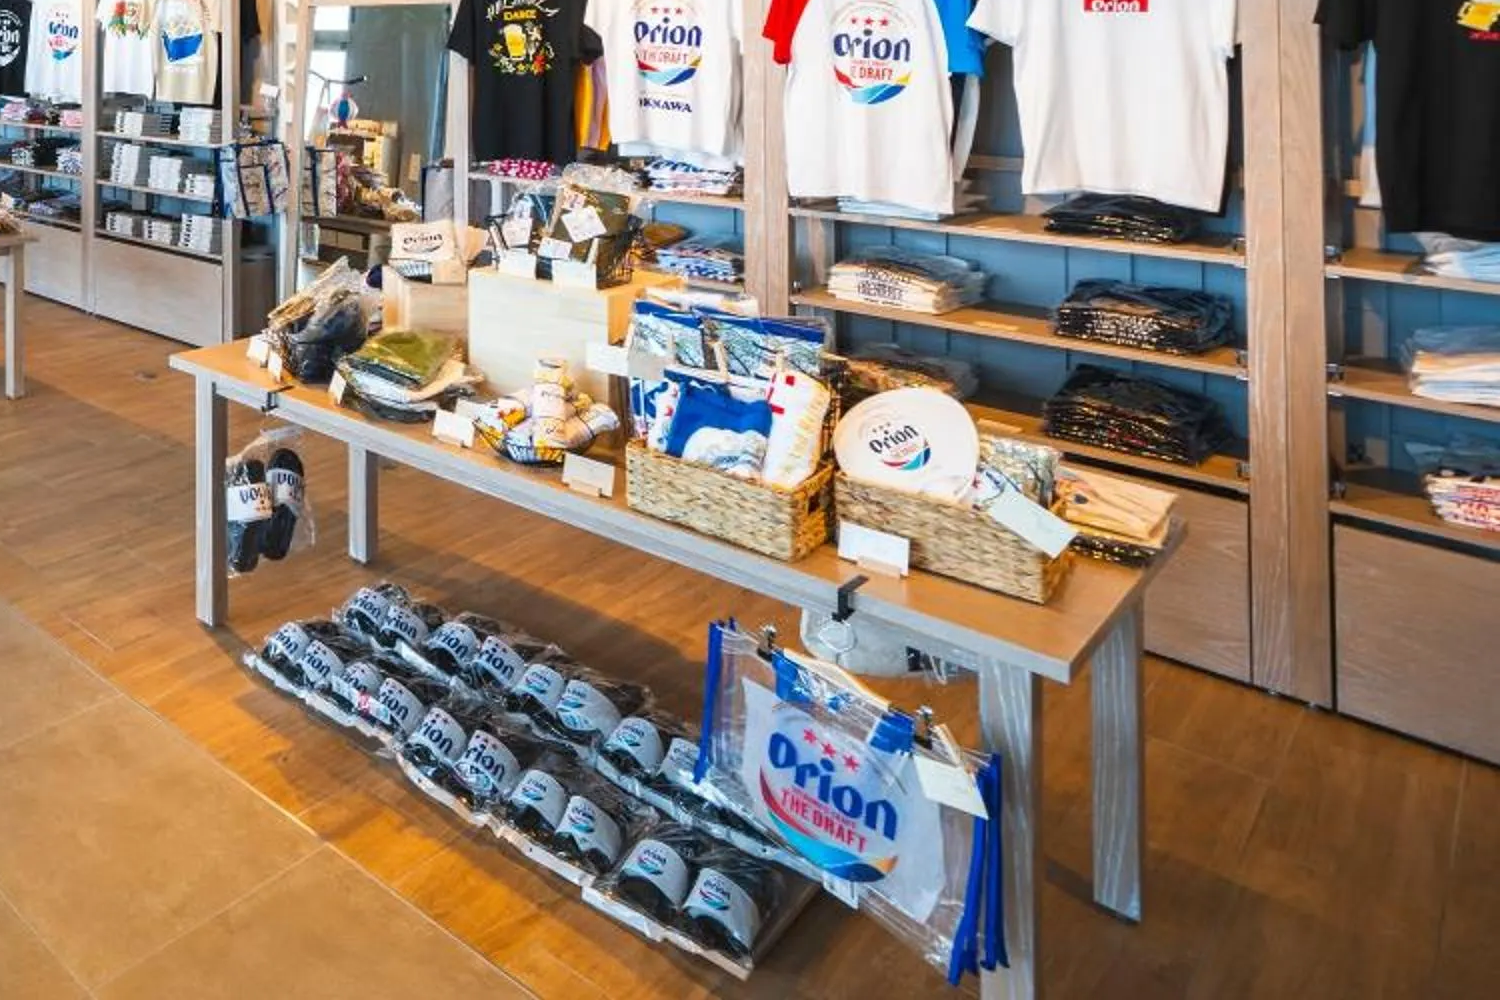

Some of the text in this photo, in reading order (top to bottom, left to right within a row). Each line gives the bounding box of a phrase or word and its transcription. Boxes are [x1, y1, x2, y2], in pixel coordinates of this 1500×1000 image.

[633, 16, 703, 47] Orion
[833, 28, 911, 62] Orion
[868, 424, 919, 454] Orion
[388, 612, 417, 640] rion
[301, 648, 331, 677] rion
[483, 647, 515, 680] rion
[465, 743, 505, 782] rion
[768, 732, 897, 841] Orion
[782, 787, 809, 817] THE
[811, 810, 867, 853] DRAFT
